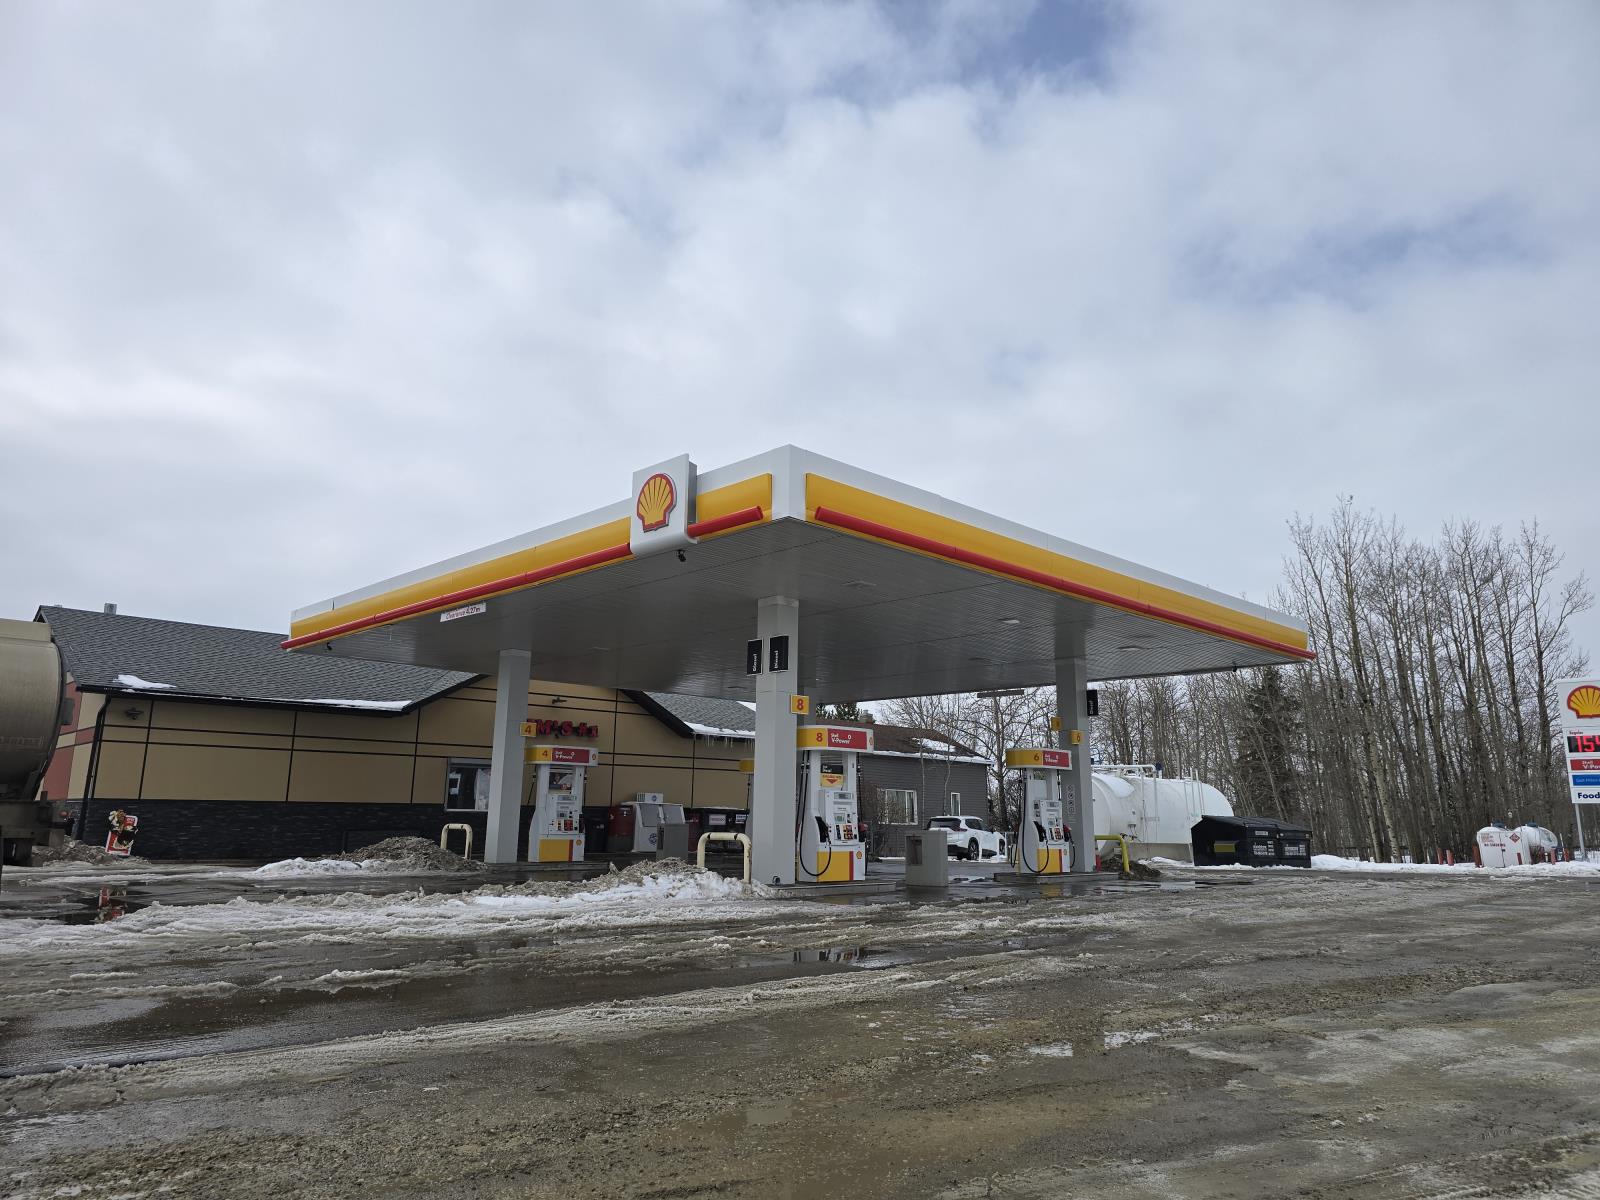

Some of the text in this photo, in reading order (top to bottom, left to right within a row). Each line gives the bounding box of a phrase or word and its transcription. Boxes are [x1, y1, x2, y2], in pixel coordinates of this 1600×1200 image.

[796, 698, 804, 711] 8
[524, 725, 532, 734] 4
[816, 732, 823, 742] 8
[1033, 753, 1040, 761] 6
